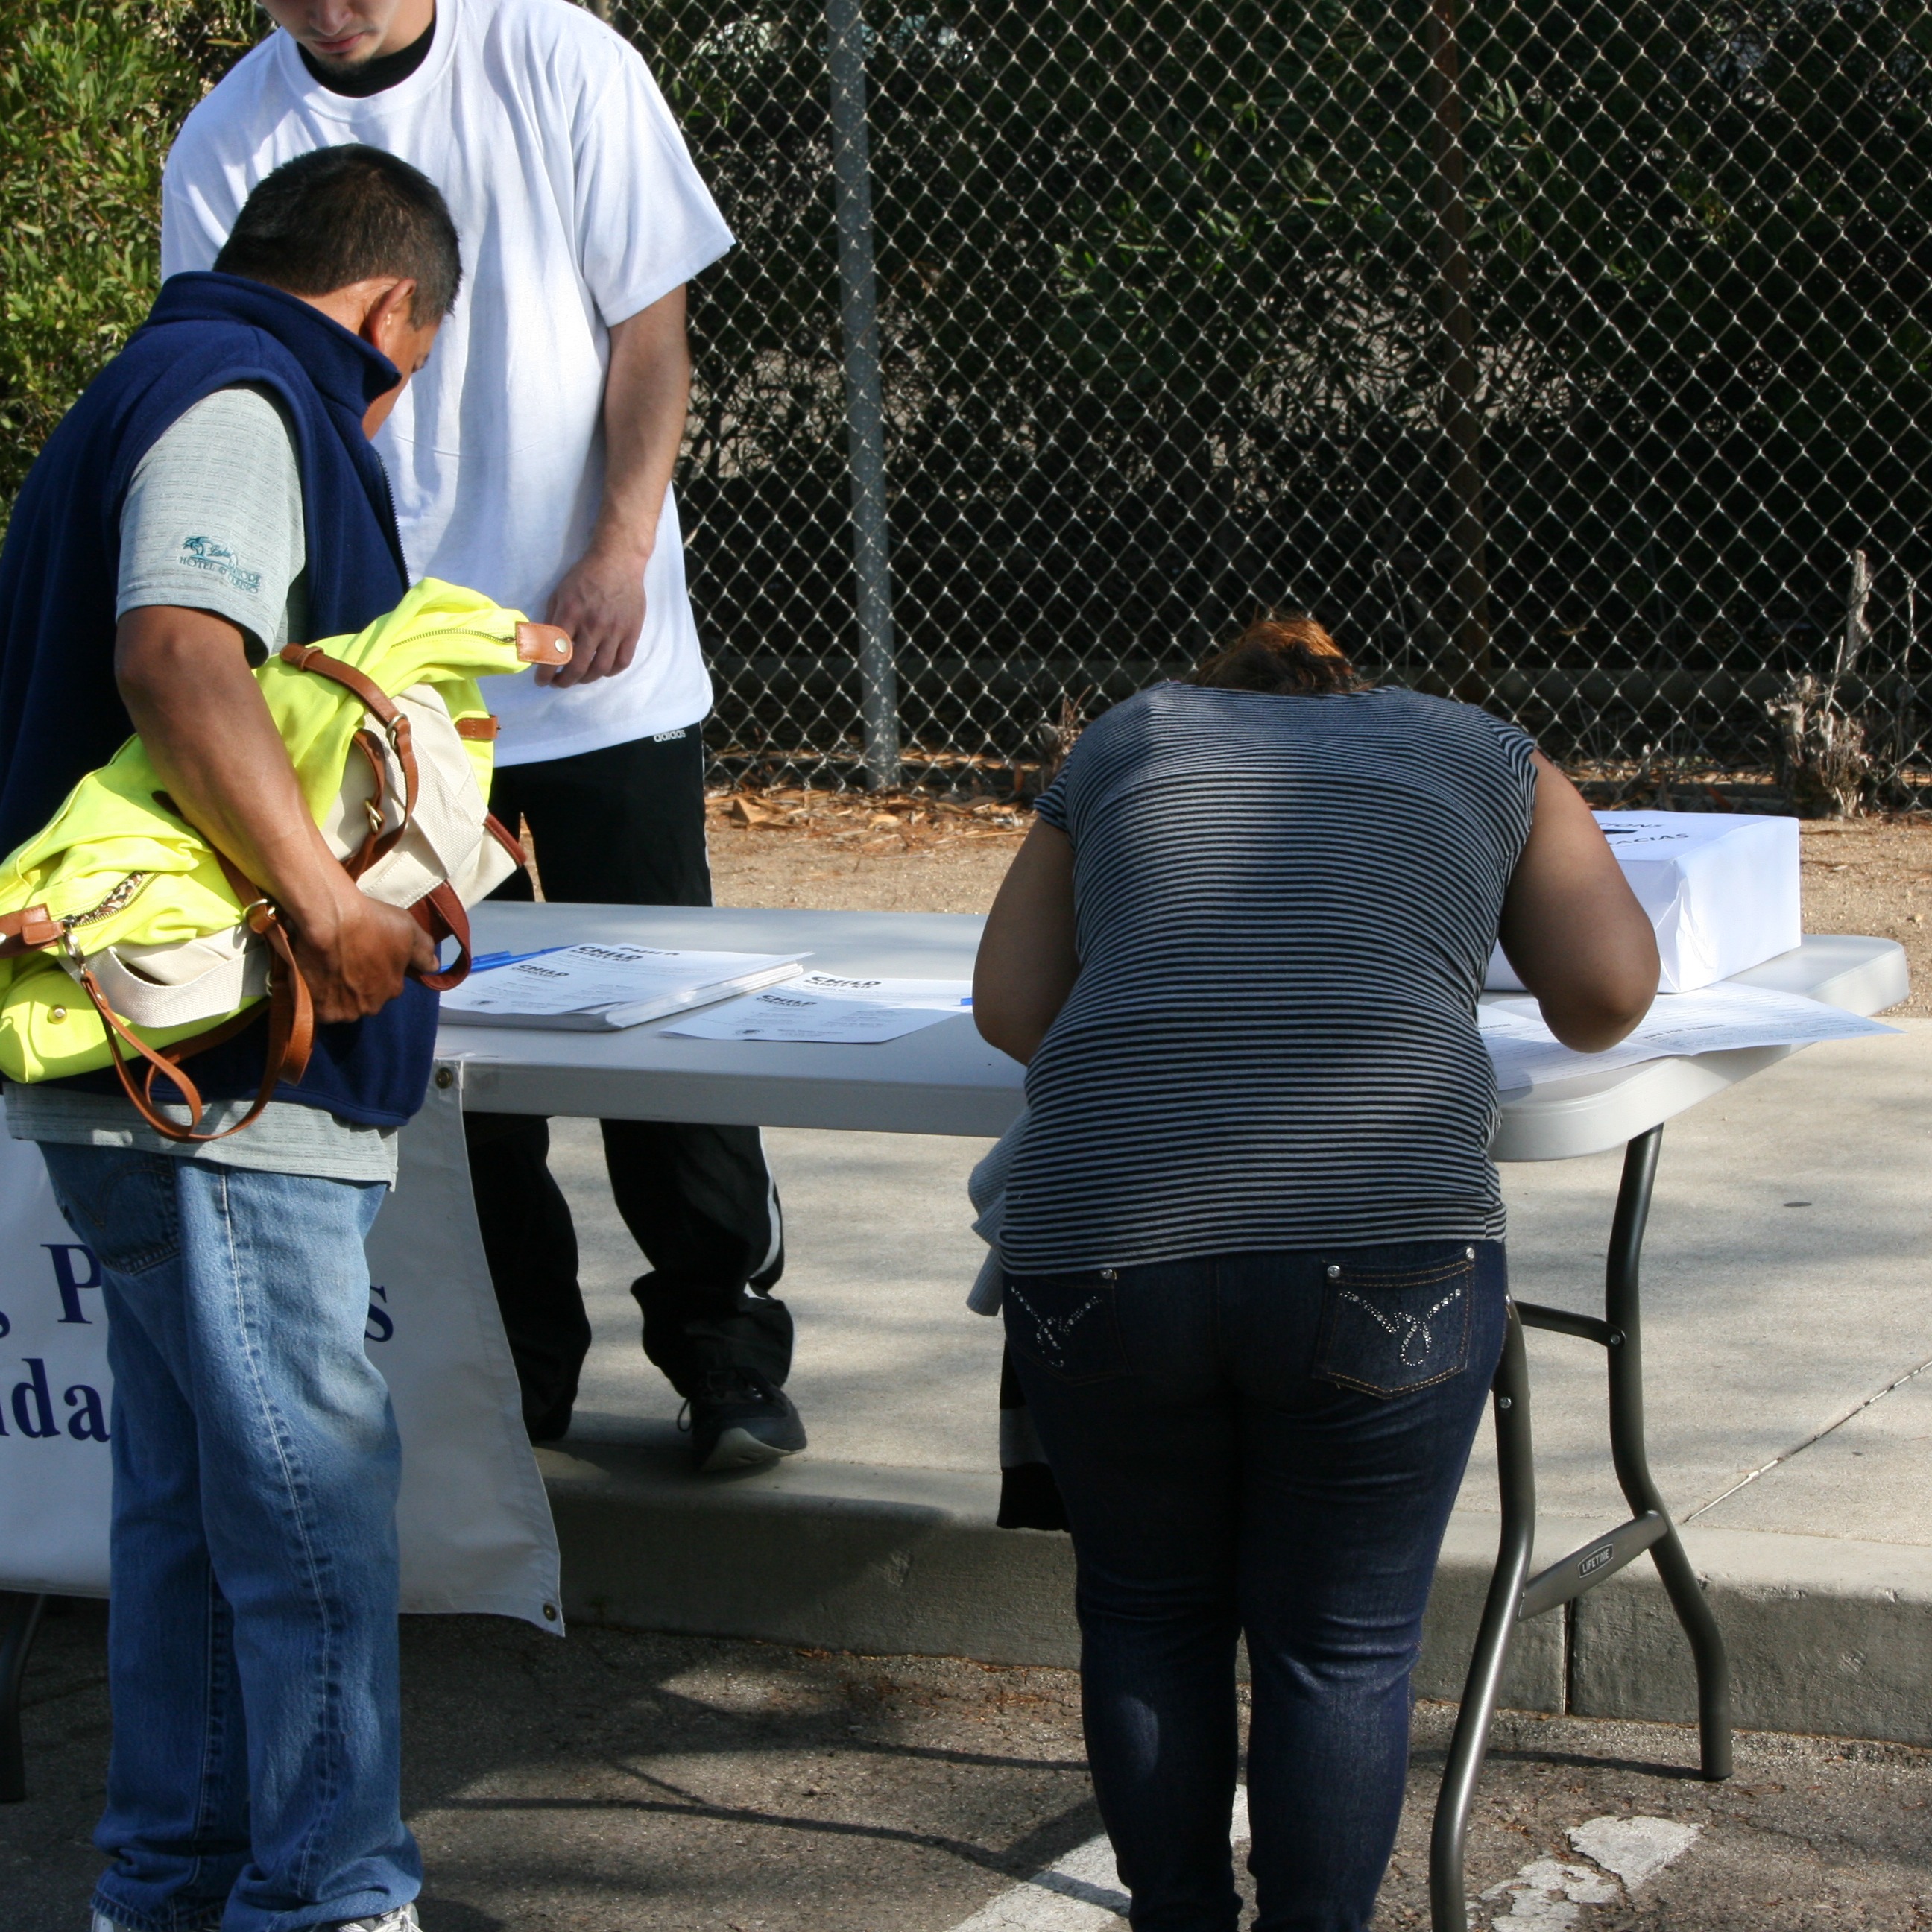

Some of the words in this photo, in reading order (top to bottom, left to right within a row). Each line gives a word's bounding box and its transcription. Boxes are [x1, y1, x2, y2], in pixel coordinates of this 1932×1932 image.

[179, 556, 215, 572] HOTEL
[654, 730, 686, 742] adidas
[578, 946, 644, 960] CHILD
[518, 965, 570, 976] CHILD
[811, 976, 882, 985] CHILD
[761, 994, 818, 1005] CHILD
[1582, 1549, 1610, 1573] LIFETIME
